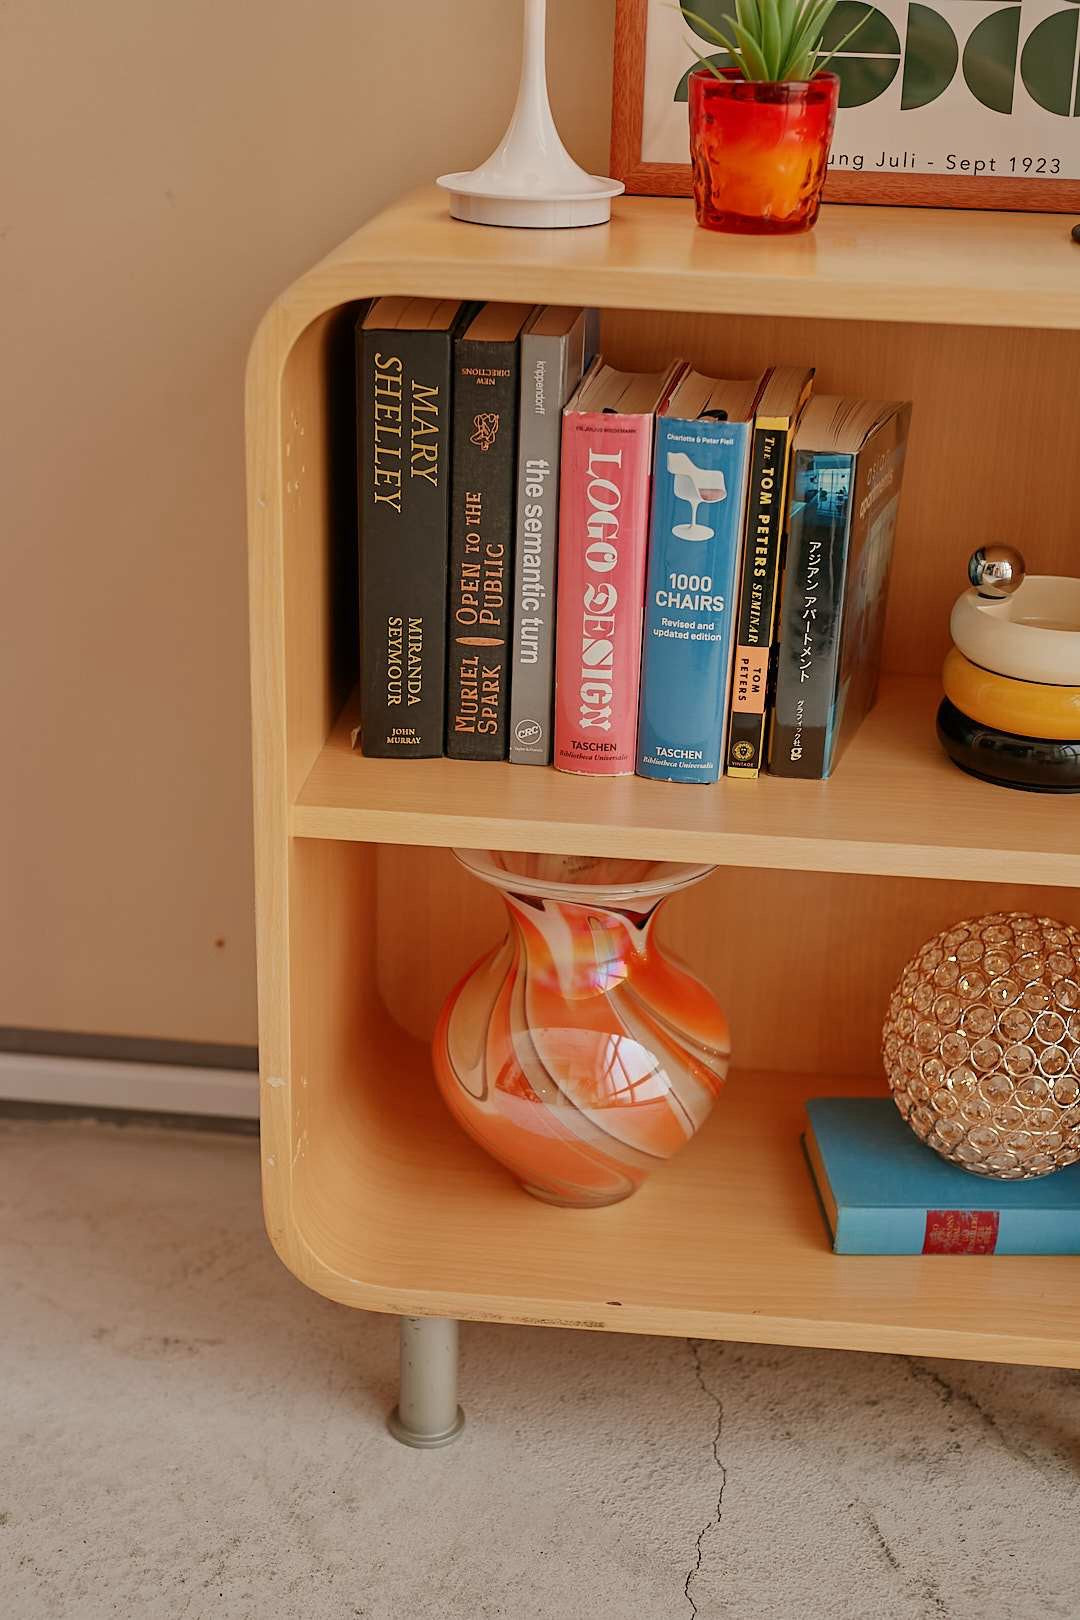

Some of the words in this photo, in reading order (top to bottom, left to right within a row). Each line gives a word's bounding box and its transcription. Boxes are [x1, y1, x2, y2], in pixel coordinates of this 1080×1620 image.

[827, 153, 864, 170] ung
[876, 151, 916, 168] Juli
[946, 154, 996, 176] Sept
[1009, 156, 1061, 174] 1923
[462, 368, 510, 377] DIRECTIONS
[476, 378, 496, 386] NEW
[534, 360, 547, 415] krippendorff
[374, 352, 403, 513] SHELLEY
[410, 380, 440, 486] MARY
[666, 433, 695, 442] Charlotte
[764, 437, 775, 460] THE
[524, 459, 550, 498] the
[759, 467, 774, 505] TOM
[465, 492, 482, 526] THE
[585, 448, 622, 573] LOGO
[465, 532, 481, 553] TO
[522, 504, 546, 611] semantic
[753, 514, 770, 577] PETERS
[455, 562, 481, 626] OPEN
[480, 544, 504, 626] PUBLIC
[669, 573, 712, 592] 1000
[655, 590, 725, 612] CHAIRS
[748, 583, 763, 644] SEMINAR
[520, 618, 544, 664] turn
[652, 628, 689, 640] updated
[690, 632, 722, 642] edition
[662, 618, 696, 630] Revised
[697, 622, 714, 631] and
[387, 616, 402, 706] SEYMOUR
[407, 617, 422, 706] MIRANDA
[579, 582, 618, 732] DESIGN
[454, 656, 480, 734] MURIEL
[738, 658, 748, 701] PETERS
[751, 668, 761, 692] TOM
[478, 664, 502, 735] SPARK
[386, 736, 422, 744] MURRAY
[392, 728, 416, 736] JOHN
[571, 740, 617, 752] TASCHEN
[560, 750, 594, 761] Bibliotheca
[643, 755, 678, 768] Bibliotheca
[678, 760, 714, 770] Universalis
[656, 746, 702, 760] TASCHEN
